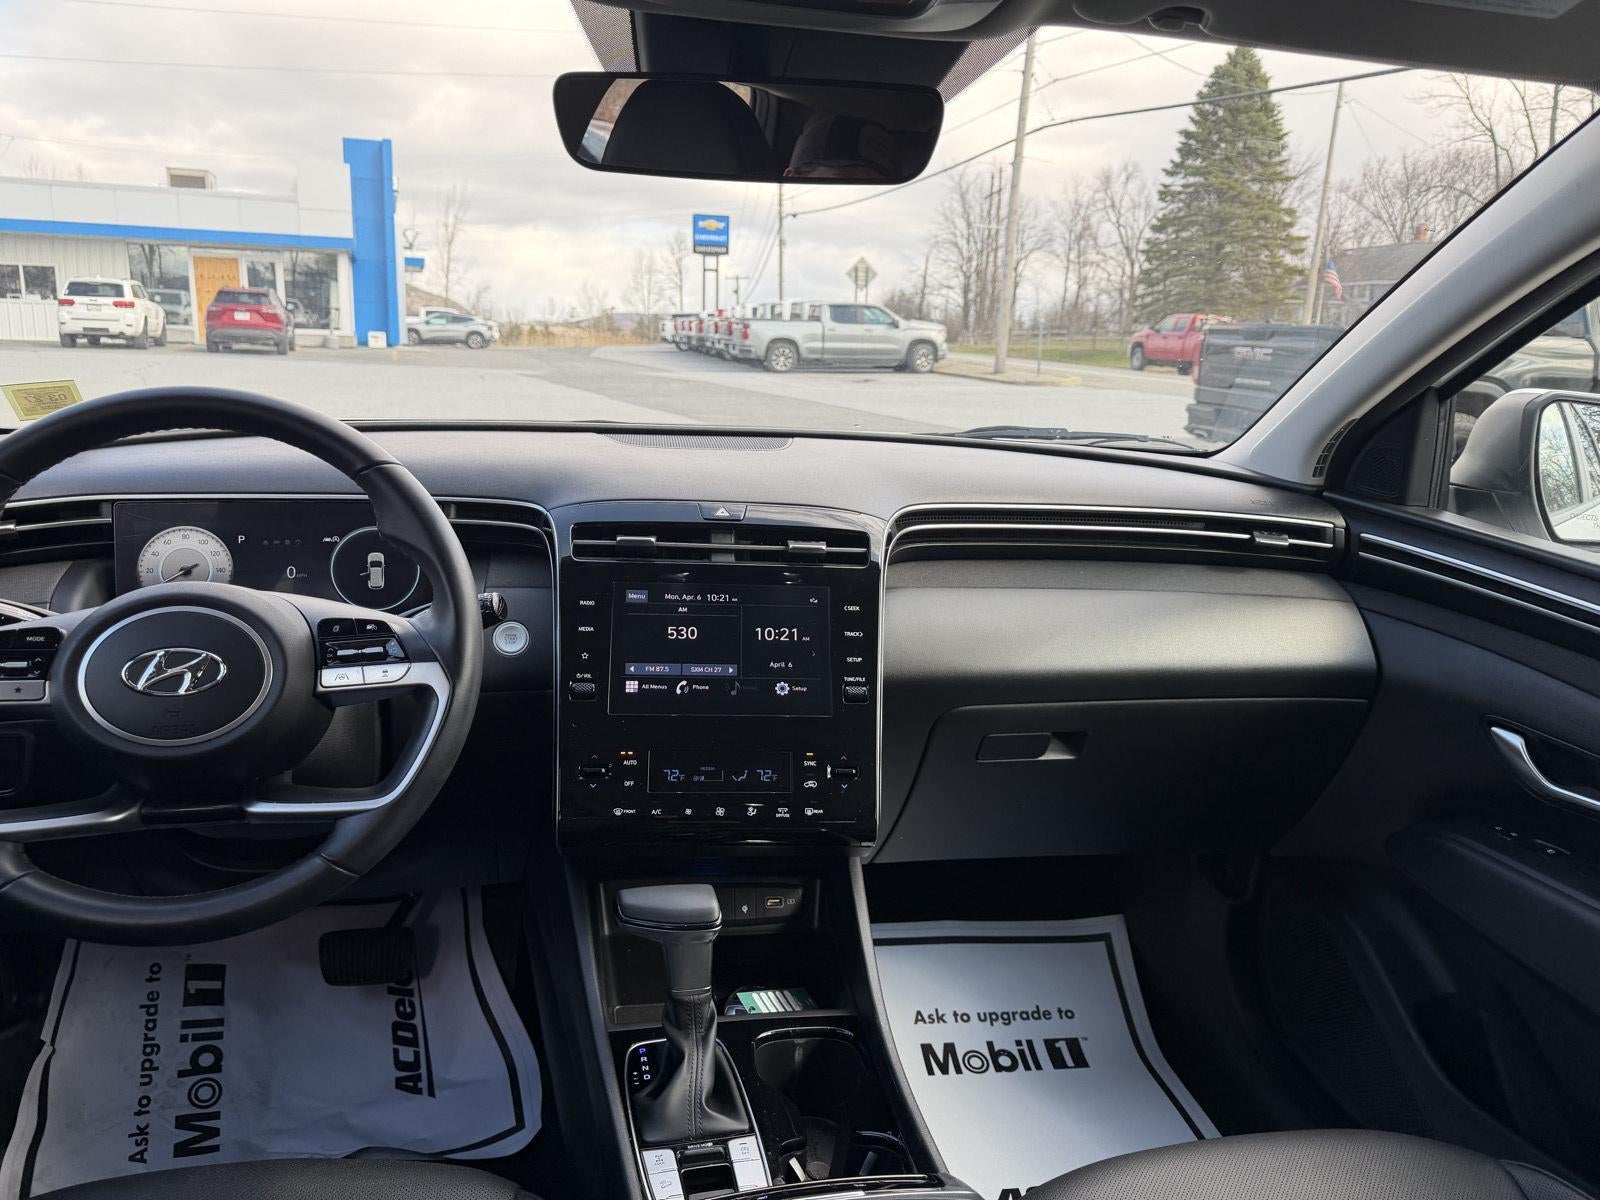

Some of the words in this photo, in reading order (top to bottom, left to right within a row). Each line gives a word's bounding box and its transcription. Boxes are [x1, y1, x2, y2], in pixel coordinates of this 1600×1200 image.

[238, 535, 246, 544] P
[286, 566, 296, 578] 0
[707, 594, 730, 602] 10:21
[668, 626, 698, 640] 530
[755, 628, 798, 640] 10:21
[145, 962, 162, 984] to
[914, 1008, 948, 1024] Ask
[952, 1010, 971, 1024] to
[977, 1005, 1052, 1026] upgrade
[1057, 1006, 1076, 1020] to
[139, 990, 161, 1087] upgrade
[920, 1038, 1043, 1076] Mobil
[172, 1017, 225, 1158] Mobil
[133, 1094, 152, 1117] to
[128, 1122, 150, 1164] Ask
